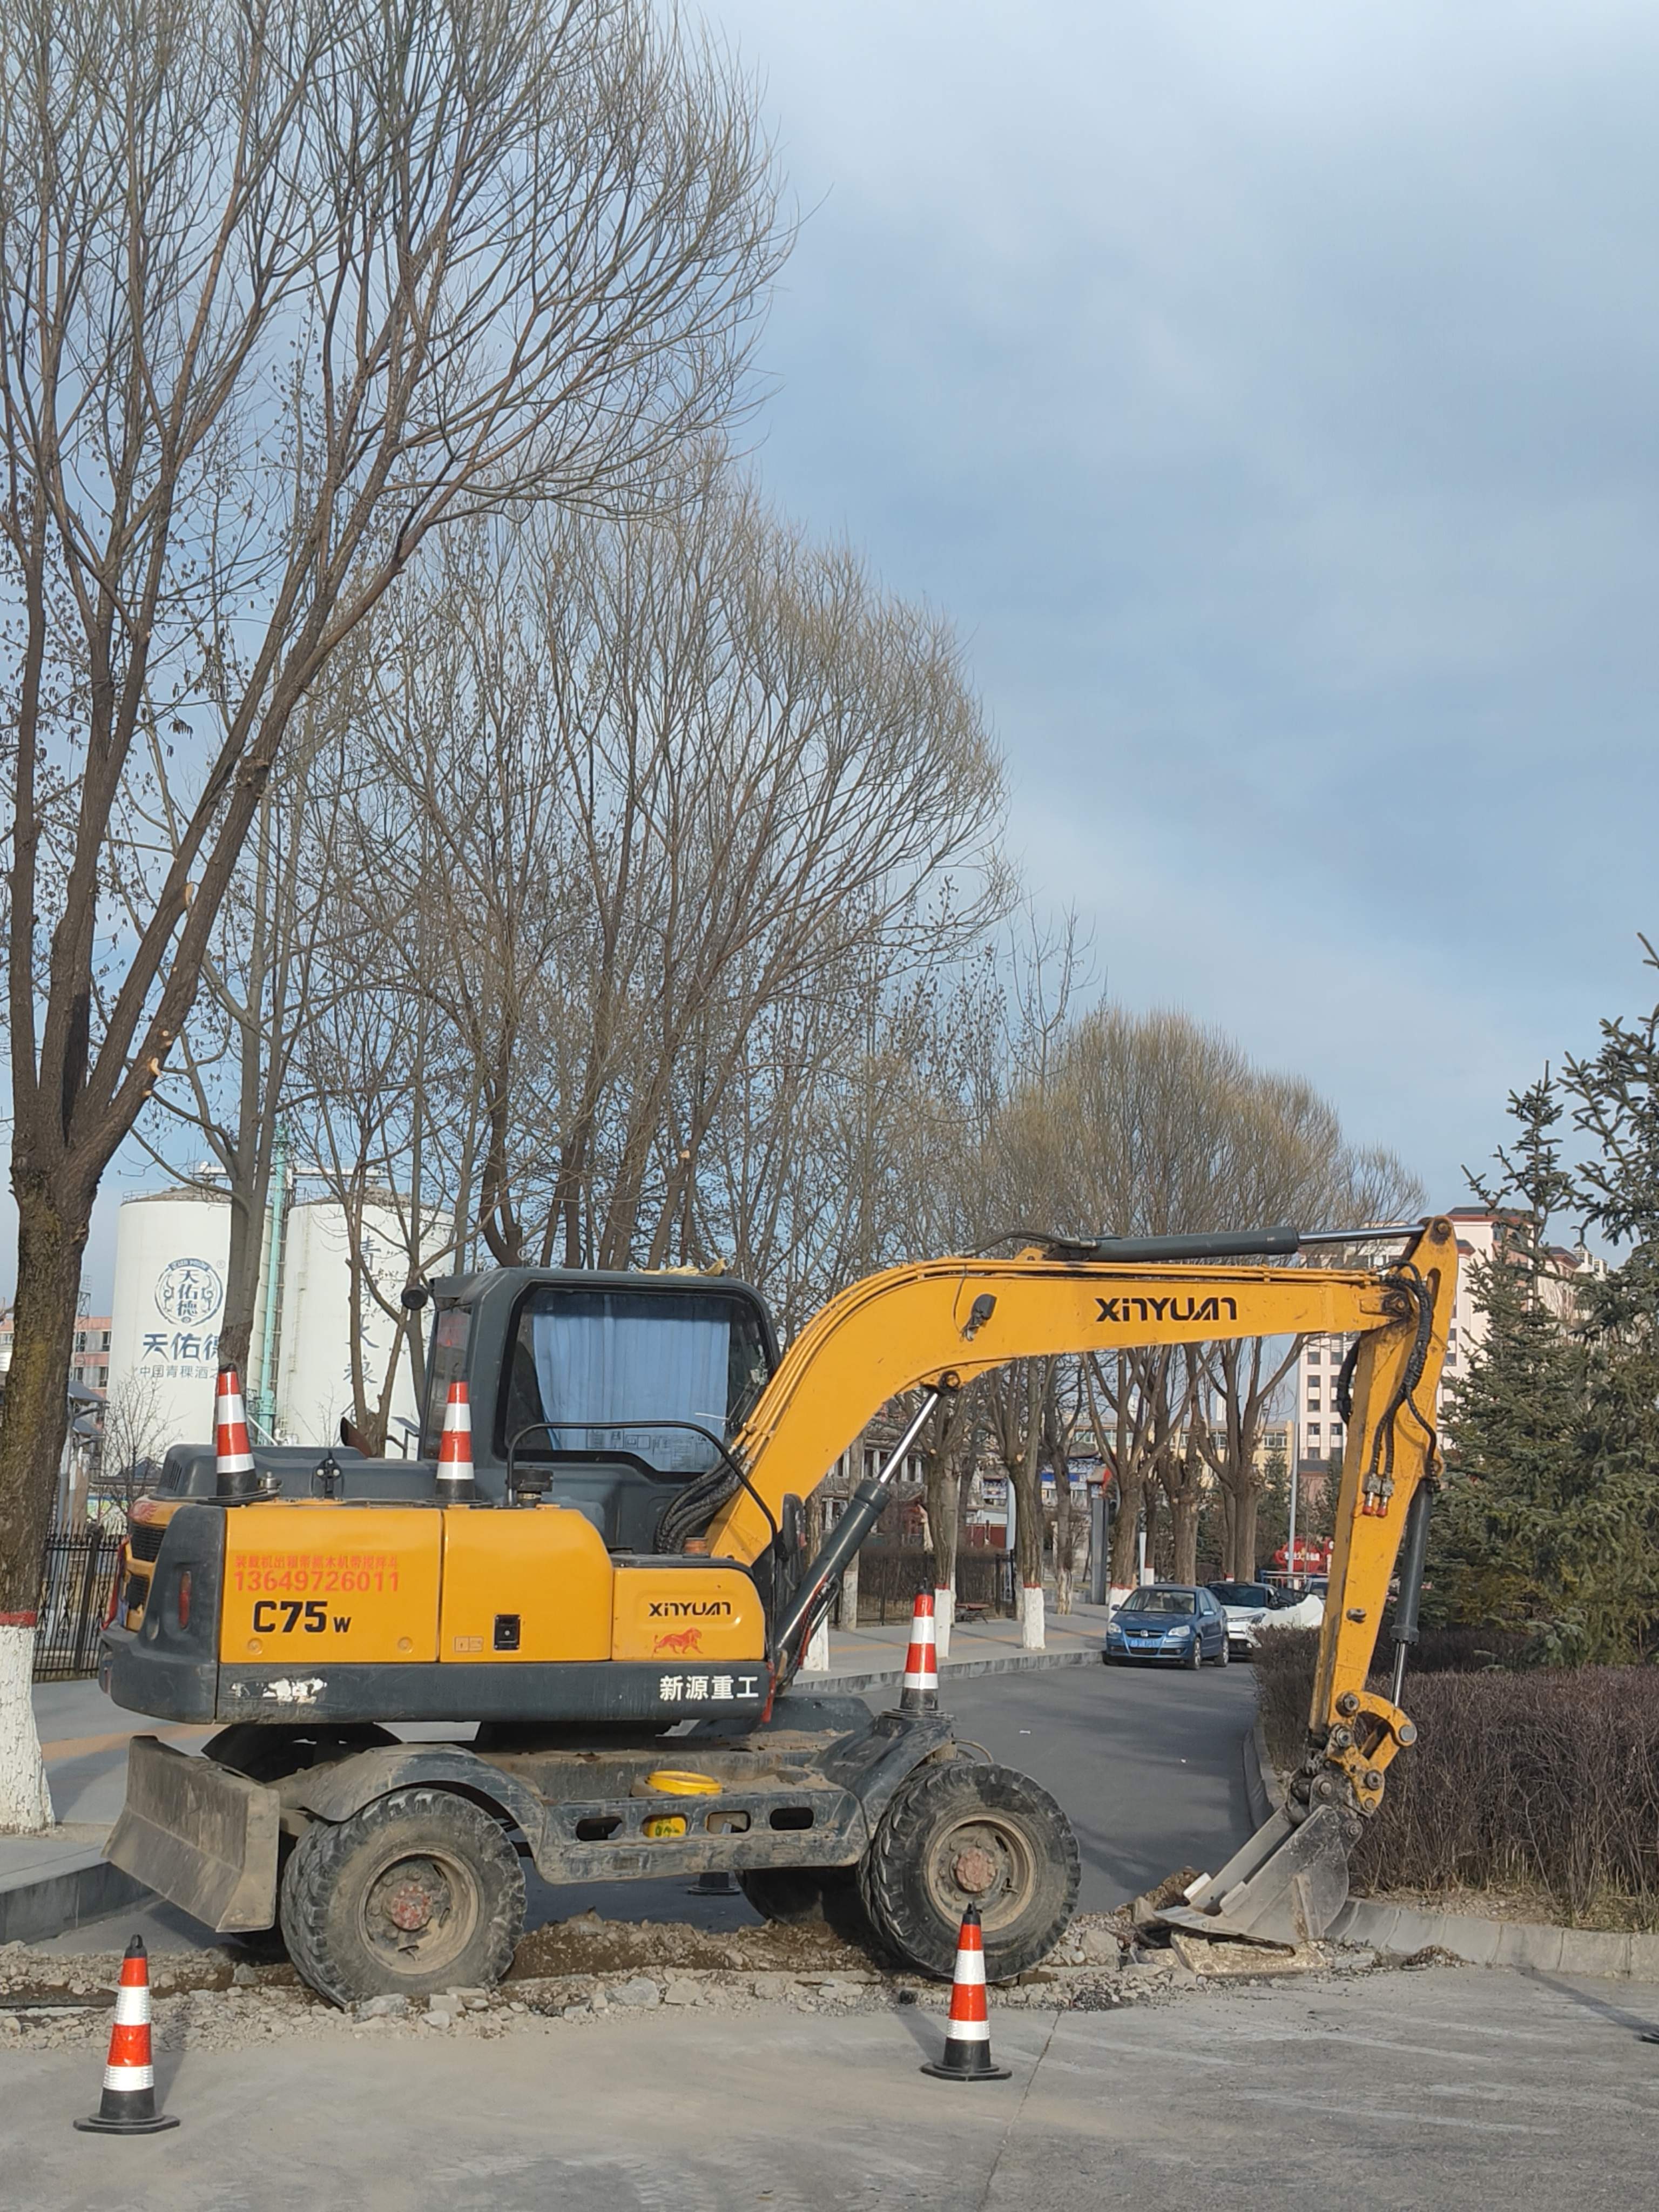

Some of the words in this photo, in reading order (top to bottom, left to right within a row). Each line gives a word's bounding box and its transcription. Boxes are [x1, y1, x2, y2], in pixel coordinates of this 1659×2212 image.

[177, 1269, 199, 1317] 天佑德
[233, 1570, 400, 1592] 13649726011
[253, 1600, 328, 1633] C75
[659, 1675, 759, 1701] 新源重工
